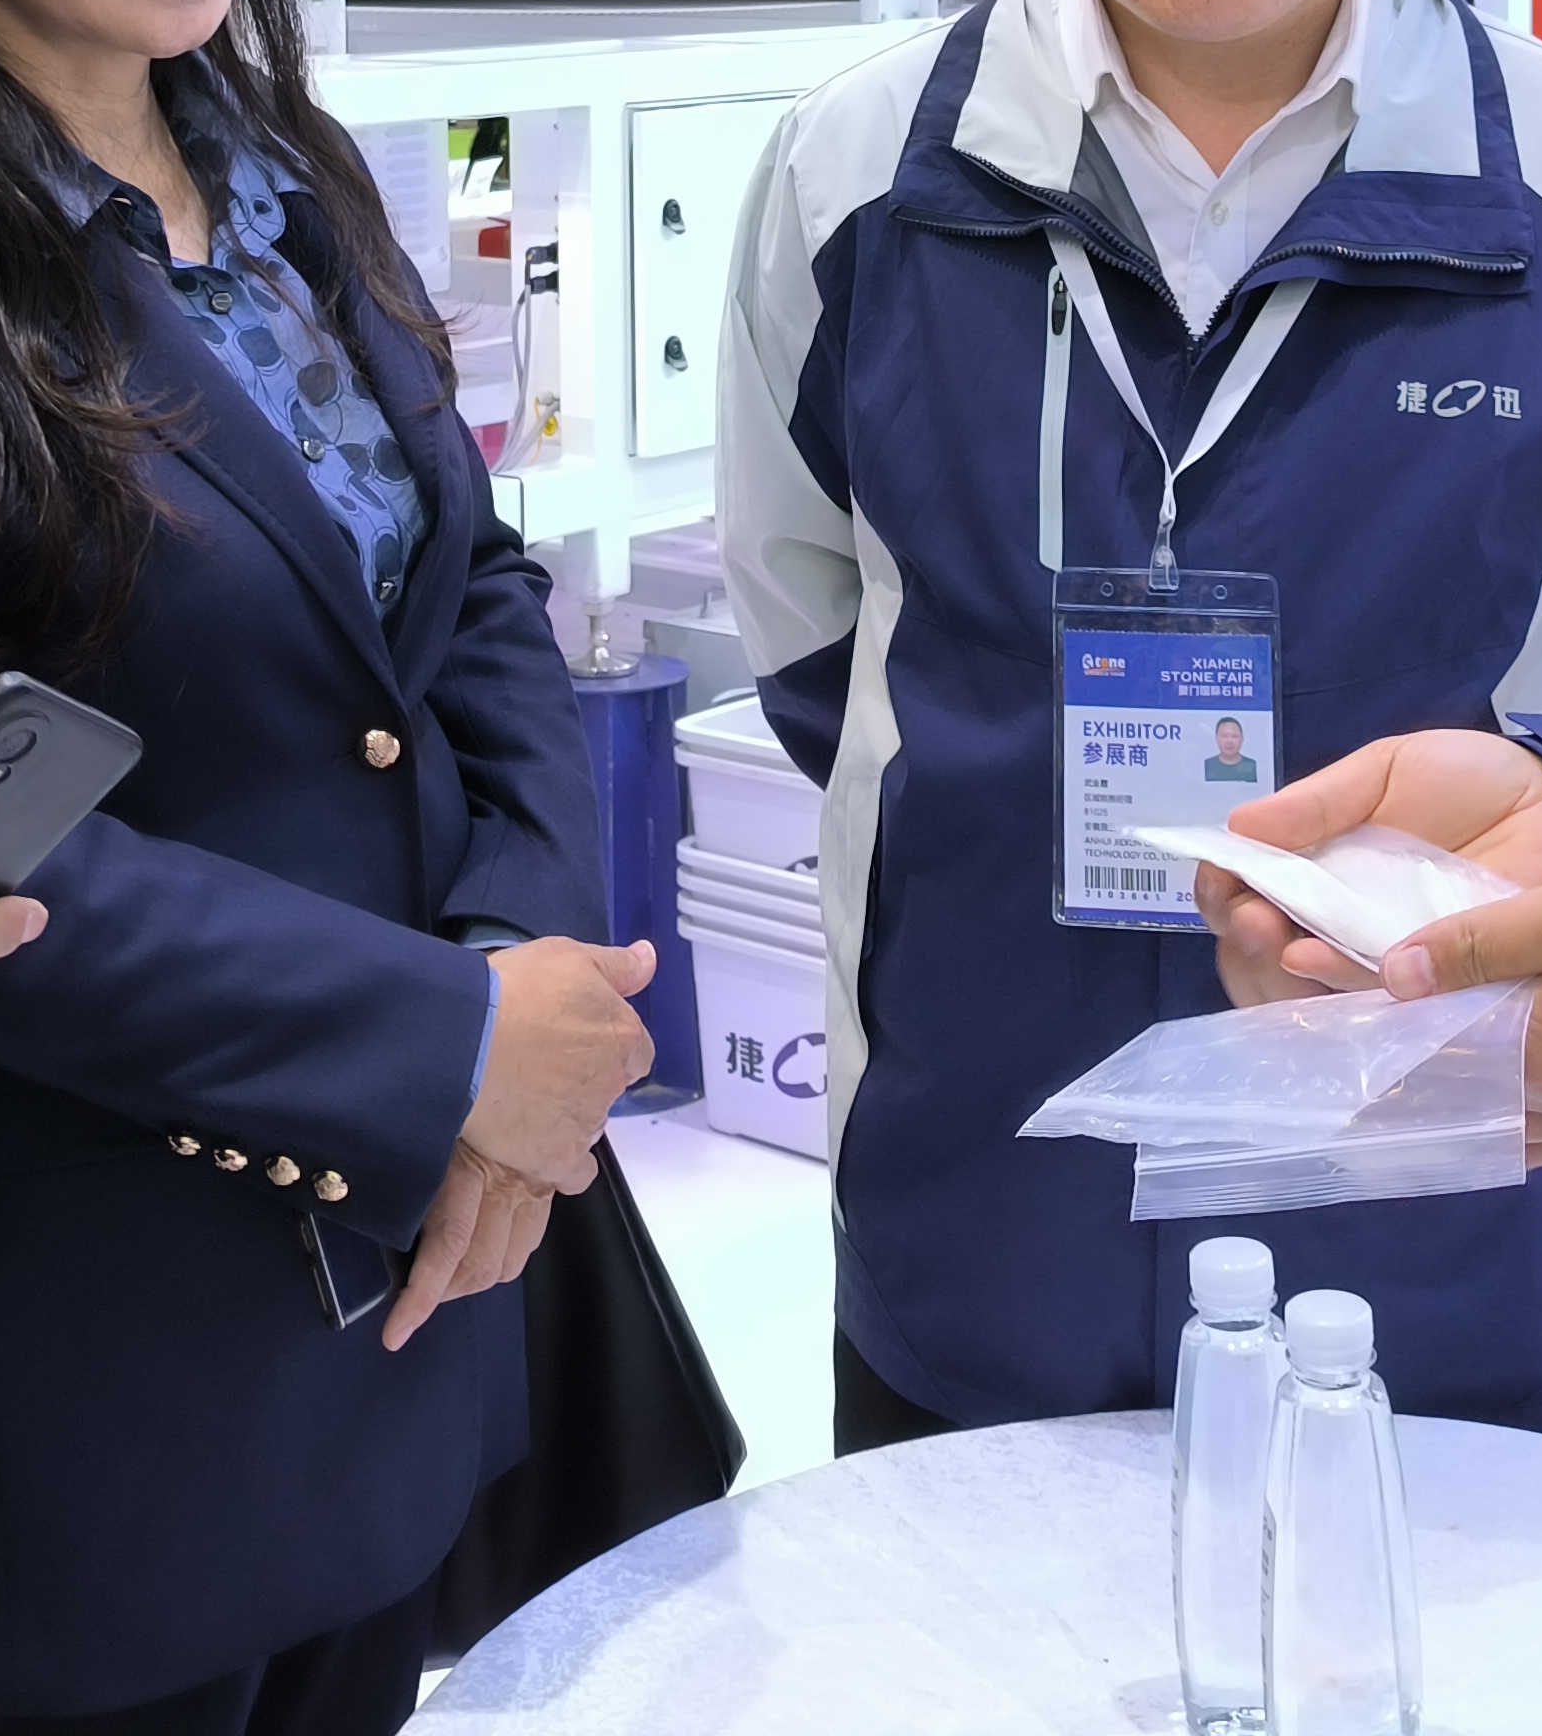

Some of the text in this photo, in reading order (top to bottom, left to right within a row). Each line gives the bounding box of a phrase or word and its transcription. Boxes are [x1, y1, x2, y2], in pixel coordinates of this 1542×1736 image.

[1192, 657, 1253, 670] XIAMEN
[1160, 670, 1253, 684] STONE FAIR
[1083, 720, 1182, 741] EXHIBITOR
[1083, 741, 1149, 767] 参展商
[1084, 848, 1141, 860] TECHNOLOGY
[726, 1032, 765, 1084] 捷
